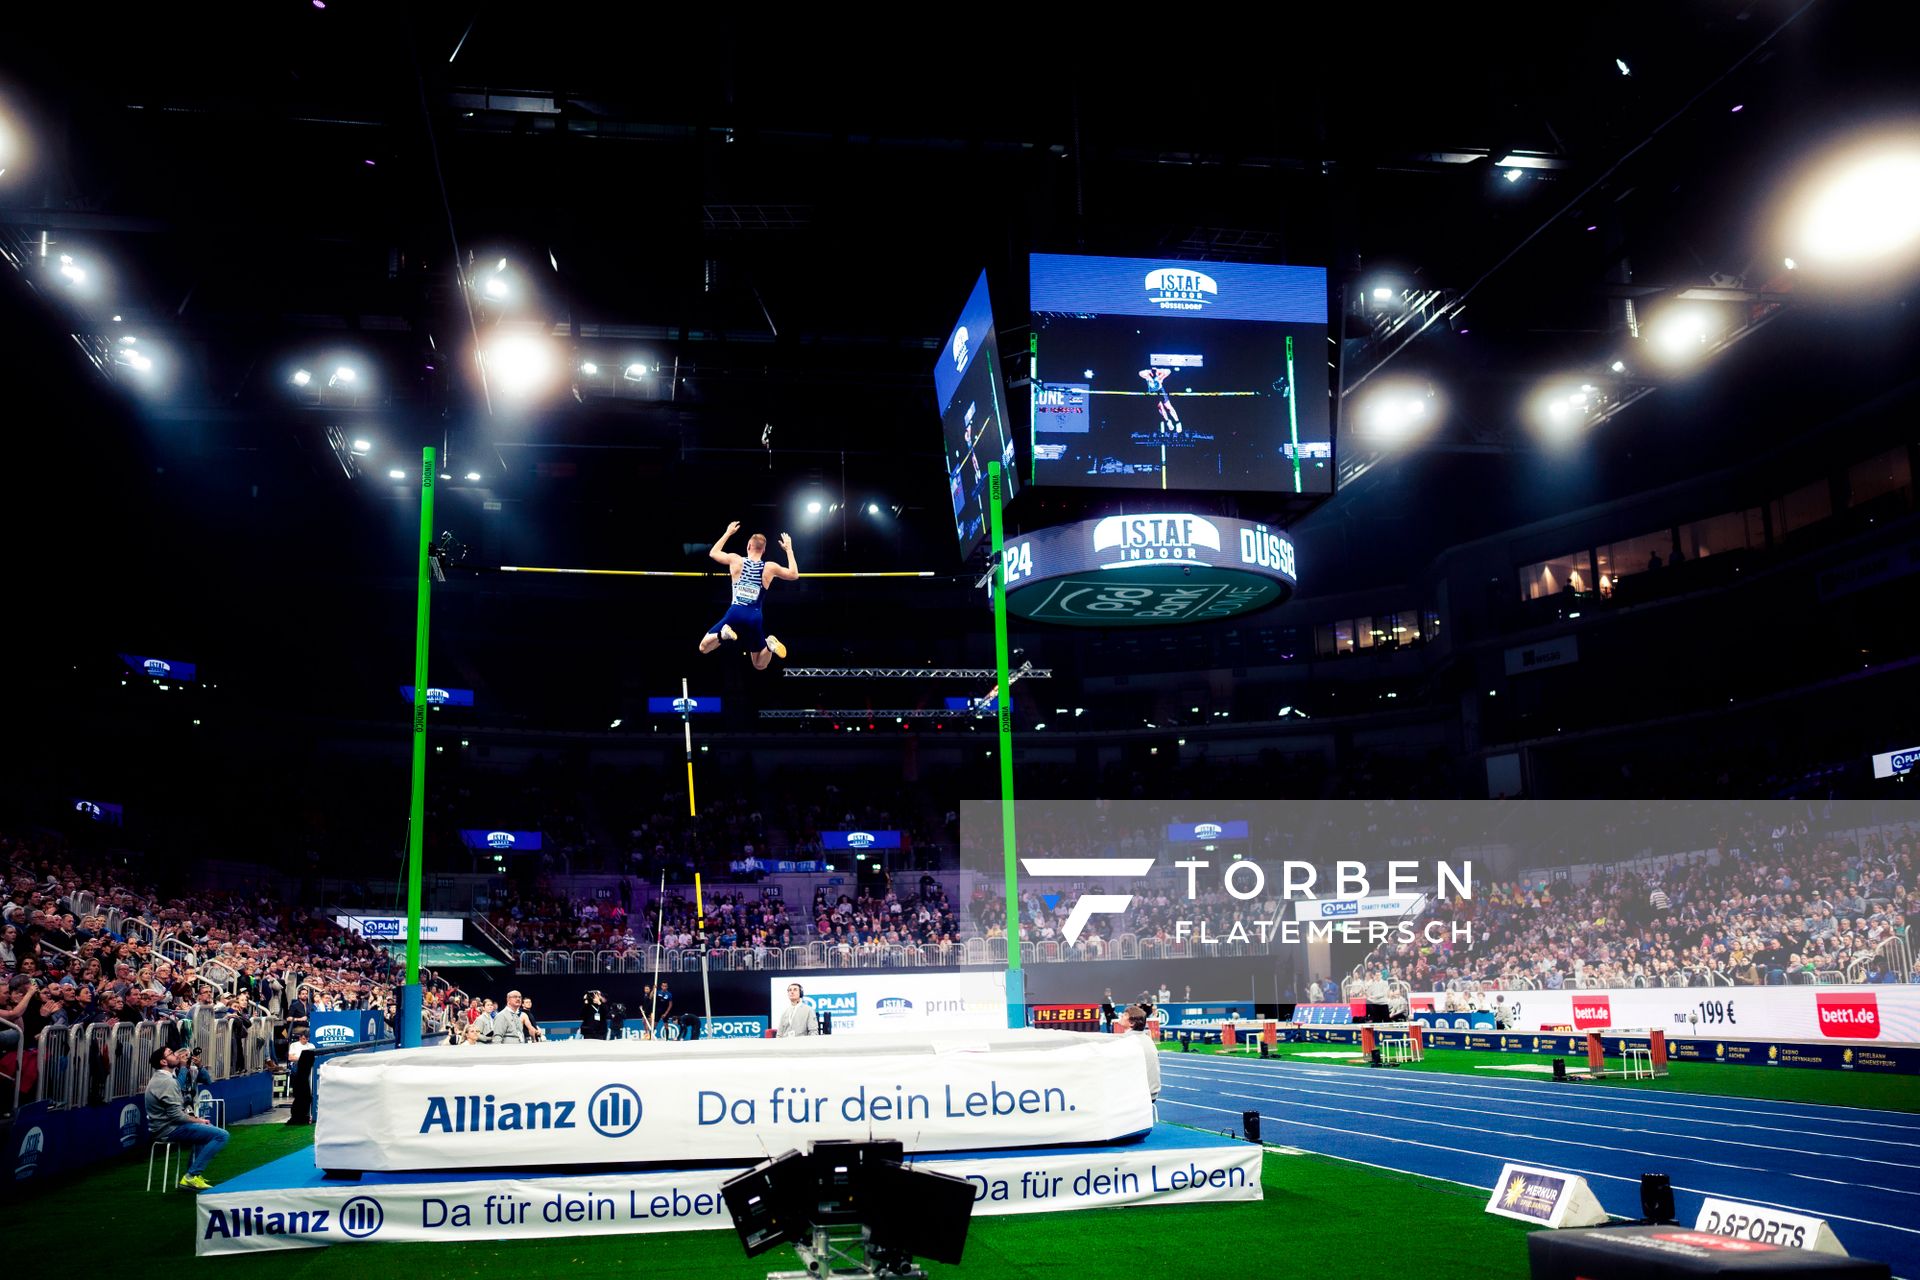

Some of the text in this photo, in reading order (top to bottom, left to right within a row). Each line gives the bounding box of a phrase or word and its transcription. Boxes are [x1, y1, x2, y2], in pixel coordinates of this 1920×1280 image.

[1161, 274, 1201, 292] ISTAF
[1160, 291, 1203, 299] INDOOR
[1160, 301, 1202, 310] DÜSSELDORF
[422, 460, 432, 488] VINDICO
[992, 474, 1000, 501] VINDICO
[1121, 519, 1193, 548] ISTAF
[1120, 548, 1197, 561] INDOOR
[378, 922, 398, 930] PLAN
[818, 997, 855, 1008] PLAN
[1037, 1008, 1099, 1020] 14:28:51
[1574, 1006, 1608, 1020] bett1.de
[1674, 1001, 1736, 1024] nur 199 €
[1821, 1007, 1875, 1024] bett1.de
[323, 1027, 346, 1037] ISTAF
[701, 1021, 761, 1034] .SPORTS
[832, 1019, 855, 1029] RTNER
[698, 1080, 1077, 1126] Da für dein Leben.
[419, 1094, 576, 1133] Allianz
[25, 1132, 41, 1153] ISTAF
[964, 1162, 1254, 1202] Da für dein Leben.
[1525, 1184, 1558, 1201] MERKUR
[422, 1198, 472, 1228] Da
[484, 1195, 531, 1225] für
[542, 1192, 615, 1223] dein
[204, 1206, 330, 1240] Allianz
[1706, 1210, 1806, 1249] D.SPORTS
